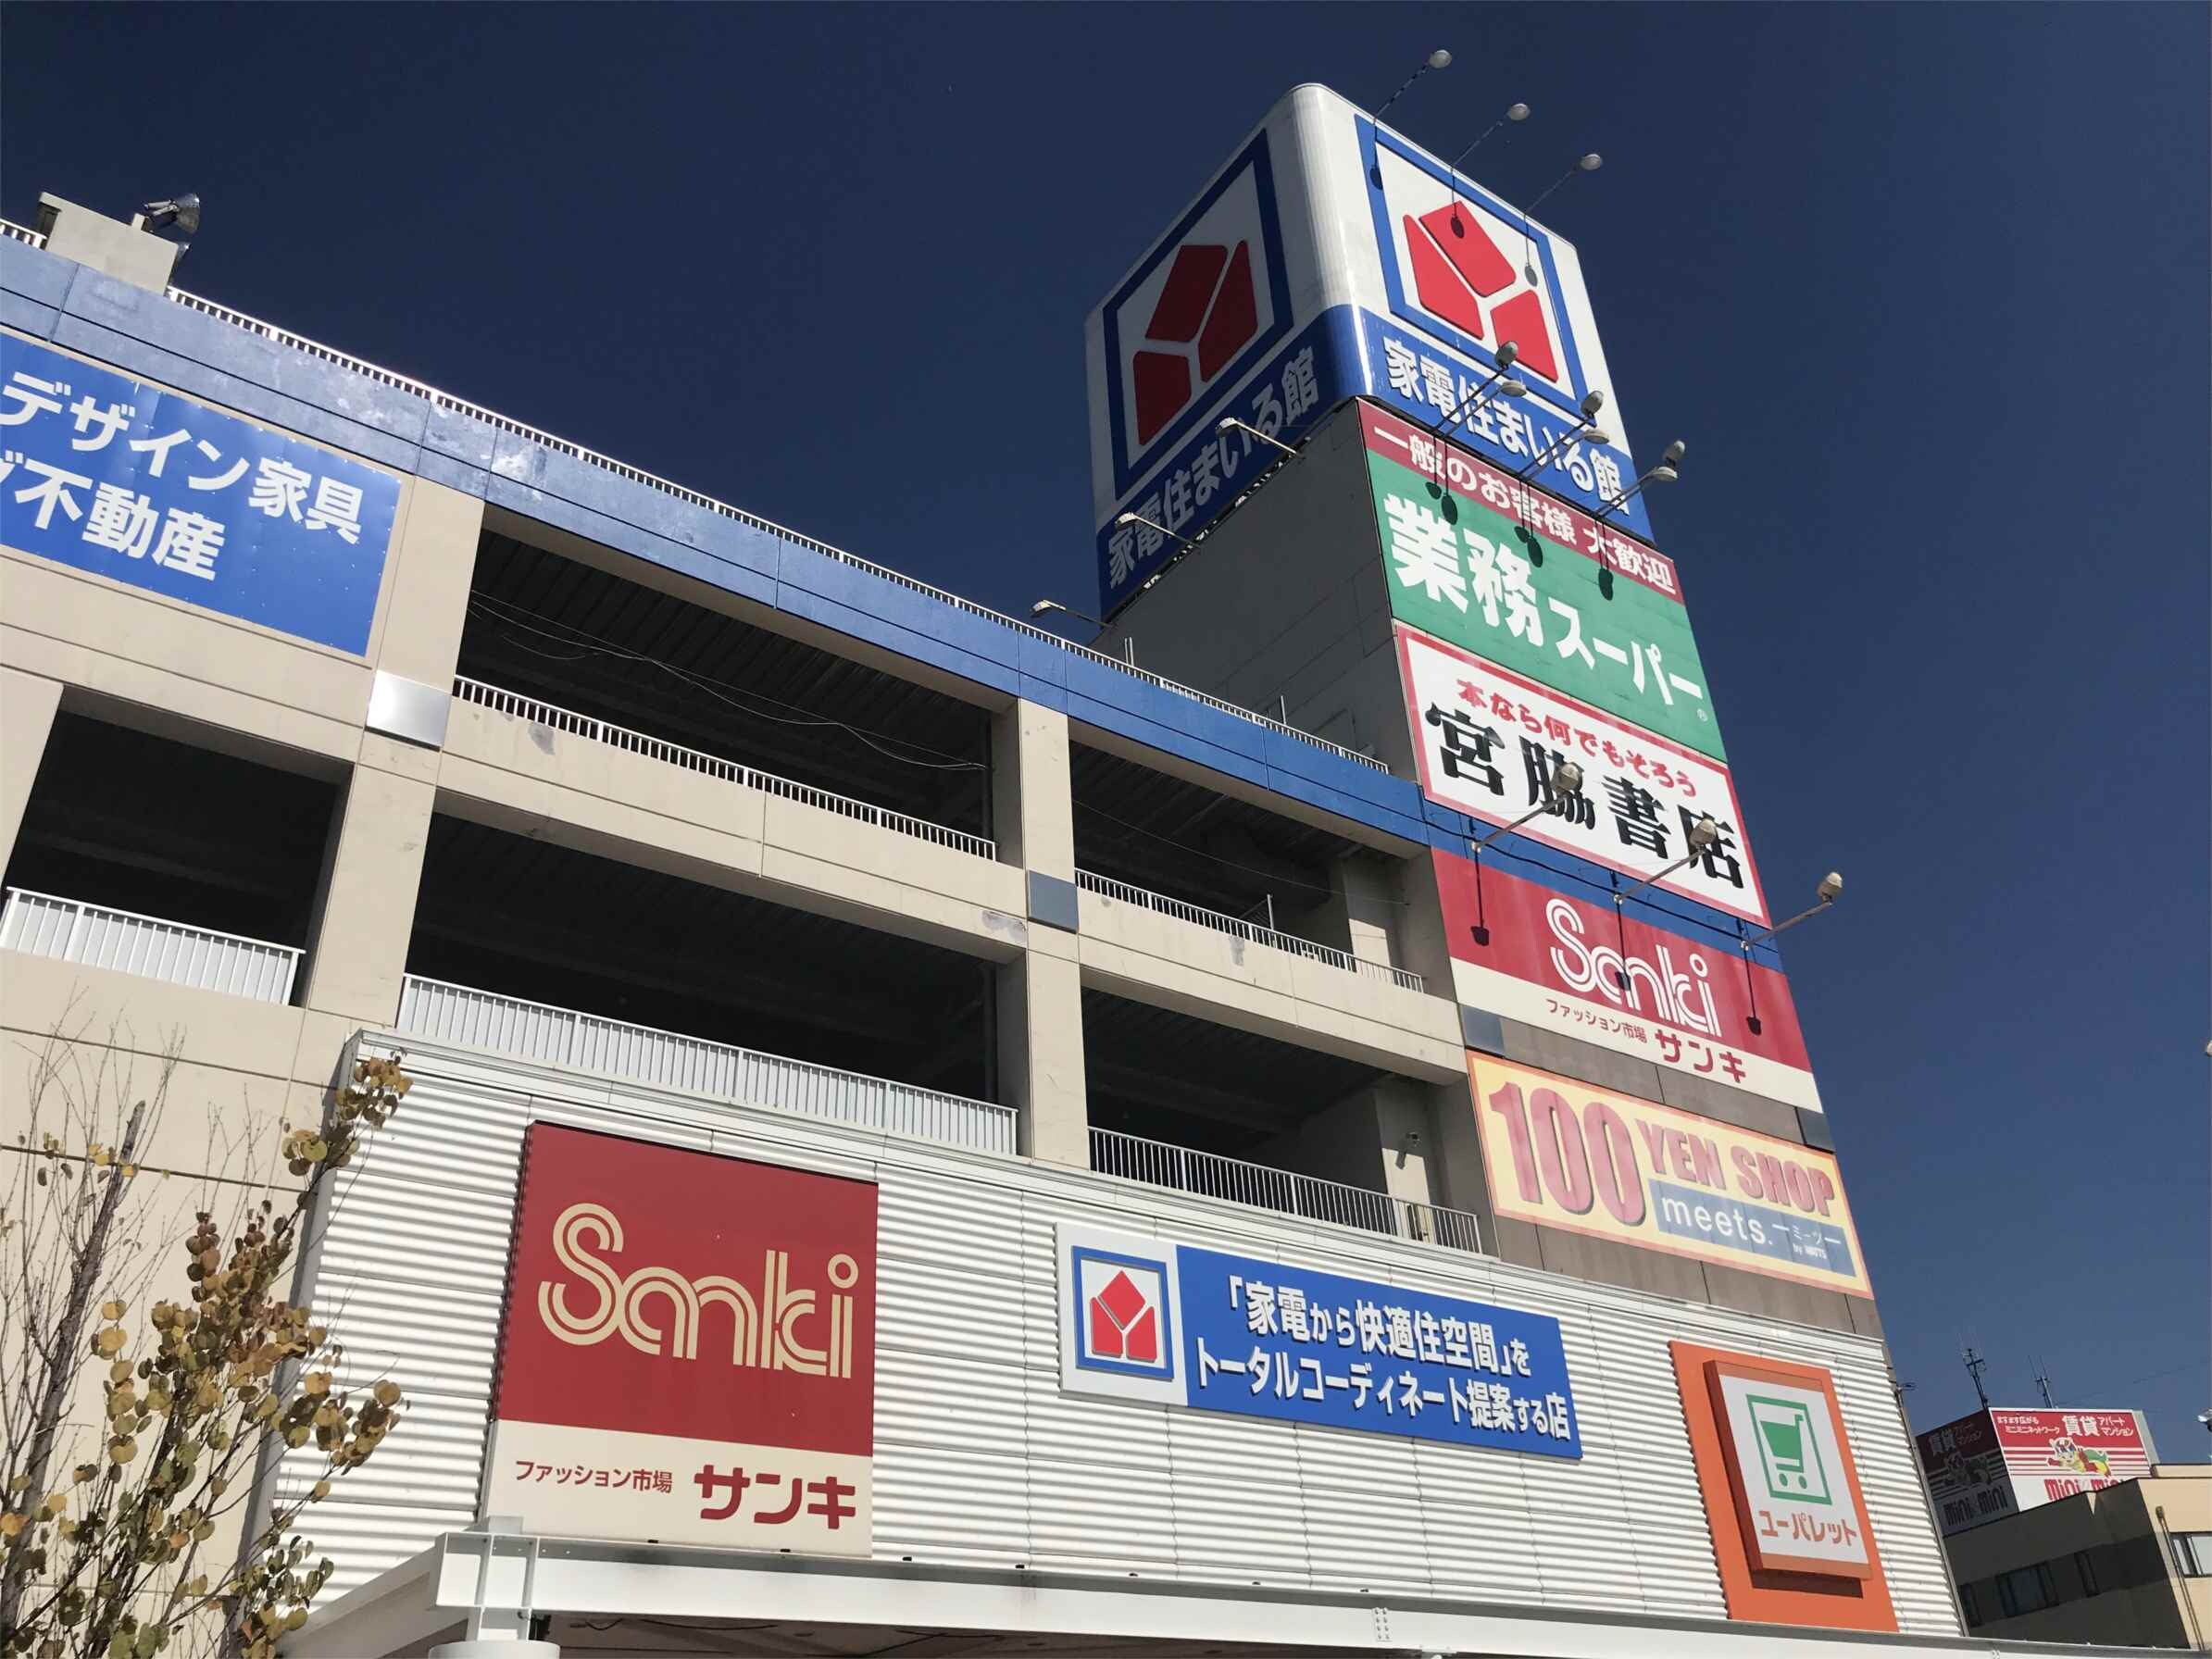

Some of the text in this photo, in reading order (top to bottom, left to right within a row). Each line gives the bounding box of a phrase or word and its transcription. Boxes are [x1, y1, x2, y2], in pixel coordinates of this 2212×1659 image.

[0, 371, 364, 545] デザイン家具
[1108, 345, 1319, 589] 家電住まいる館
[1383, 336, 1630, 516] 家電住まいる館
[1373, 426, 1676, 595] 一般のお客様 大歓迎
[1384, 493, 1703, 705] 業務スーパー
[1425, 702, 1744, 889] 宮脇書店
[1456, 679, 1697, 797] 本なら何でもそろう
[1545, 898, 1722, 1038] Sanki
[1545, 998, 1747, 1084] ファッション市場 サンキ
[1489, 1080, 1836, 1227] 100 YEN SHOP
[537, 1202, 859, 1379] Sanki
[1229, 1275, 1531, 1378] 「家電から快適住空間」を
[1196, 1336, 1572, 1441] トータルコーディネート提案する店
[2061, 1415, 2101, 1436] 賃貸
[2096, 1416, 2126, 1427] アパート
[2101, 1427, 2134, 1436] マンション
[515, 1460, 857, 1530] ファッション市場 サンキ
[1758, 1510, 1857, 1547] ユーパレット
